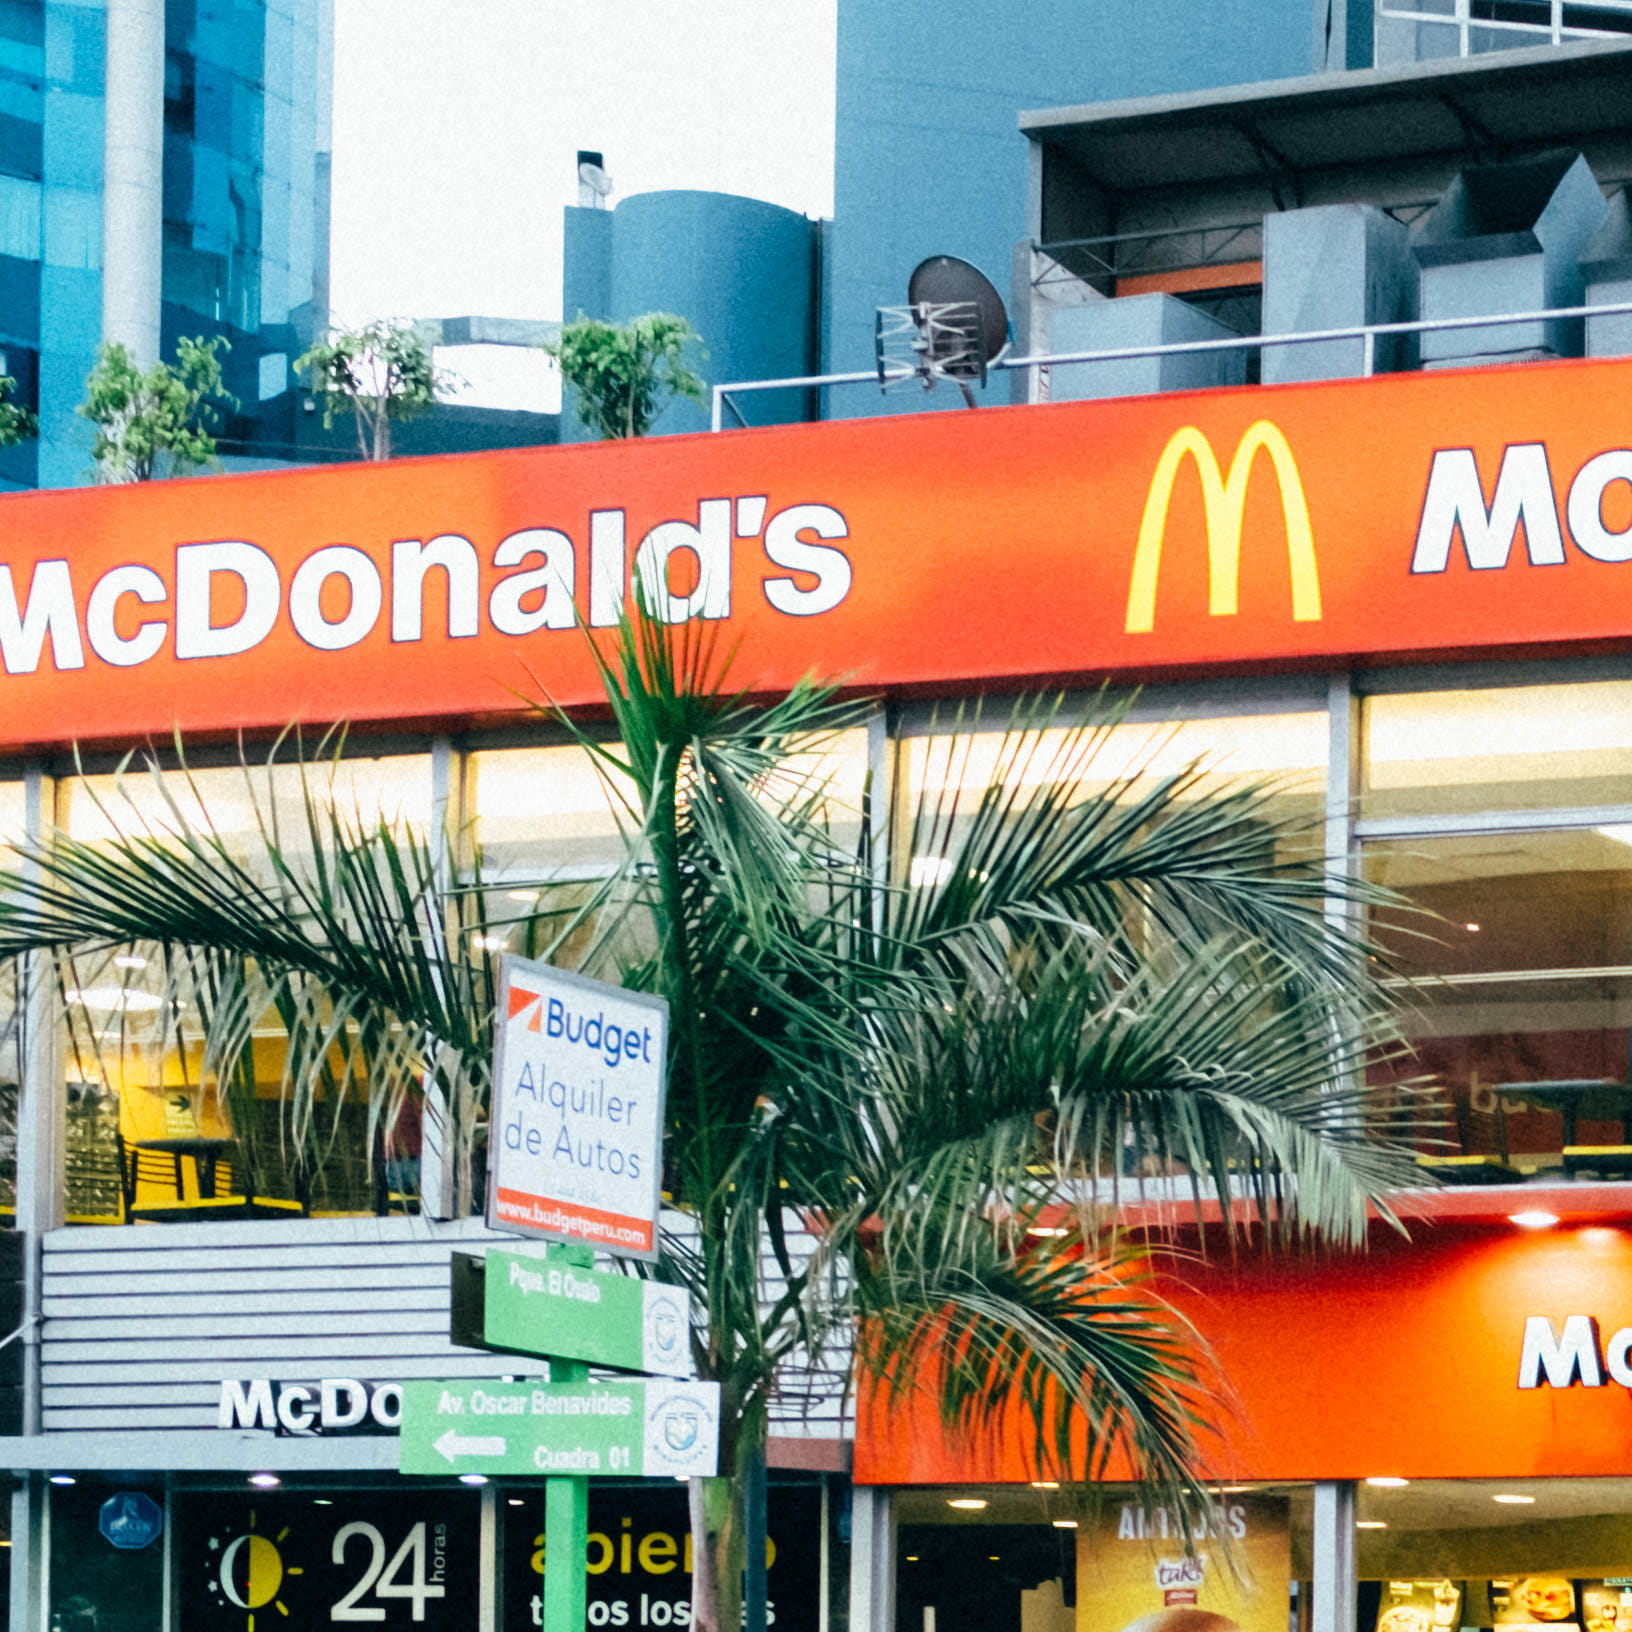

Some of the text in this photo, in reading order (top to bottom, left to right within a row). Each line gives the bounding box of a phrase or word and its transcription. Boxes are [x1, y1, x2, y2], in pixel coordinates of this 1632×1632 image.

[0, 494, 853, 675] McDonald's
[546, 998, 652, 1068] Budget
[515, 1061, 637, 1127] Alquiler
[505, 1111, 641, 1179] de Autos
[497, 1199, 646, 1246] www.budgetperu.com
[548, 1269, 562, 1296] El
[436, 1390, 632, 1416] Av. Oscar Benavides
[533, 1446, 630, 1469] Cuadra 01
[331, 1521, 445, 1621] 24
[429, 1523, 447, 1583] horas
